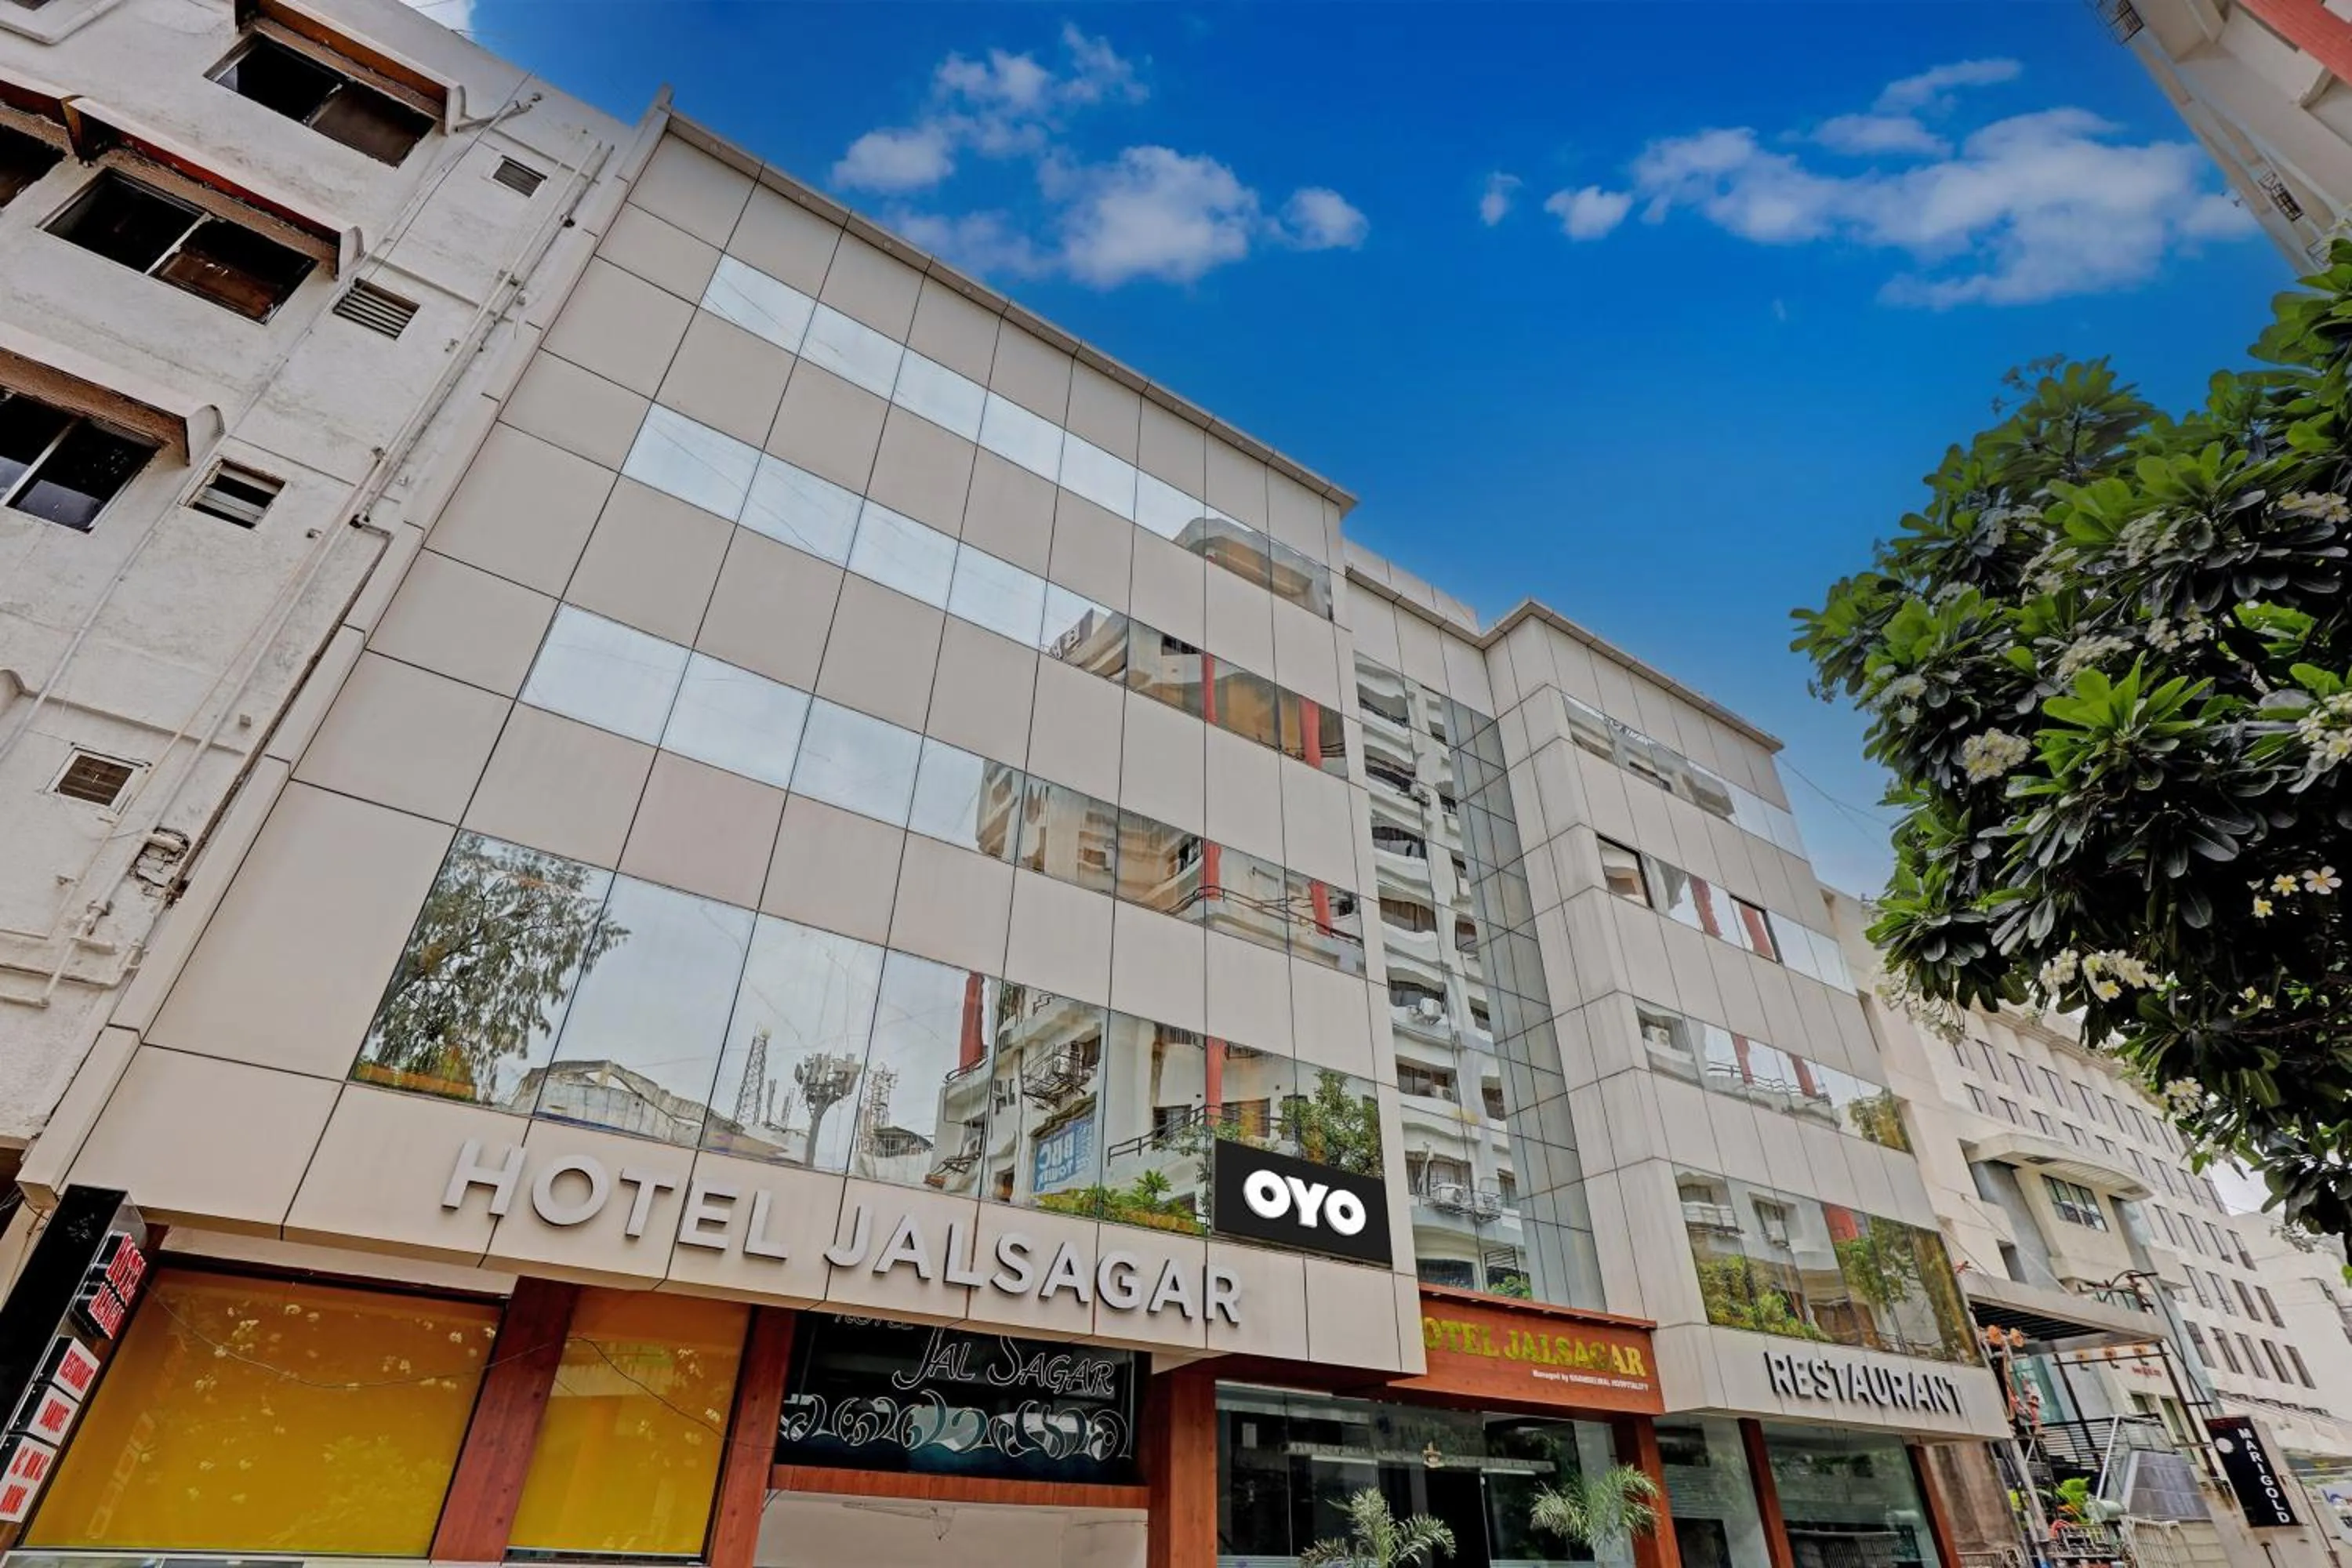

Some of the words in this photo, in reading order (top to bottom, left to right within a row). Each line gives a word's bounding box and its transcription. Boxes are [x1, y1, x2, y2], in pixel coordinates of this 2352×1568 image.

[441, 1139, 789, 1260] HOTEL
[824, 1202, 1243, 1326] JALSAGAR
[1242, 1169, 1367, 1237] OYO
[892, 1324, 976, 1390] JAL
[986, 1335, 1114, 1395] SAGAR
[1423, 1316, 1499, 1357] OTEL
[1504, 1330, 1646, 1377] JALSAGAR
[1763, 1351, 1963, 1414] RESTAURANT
[2237, 1427, 2291, 1524] MARIGOLD
